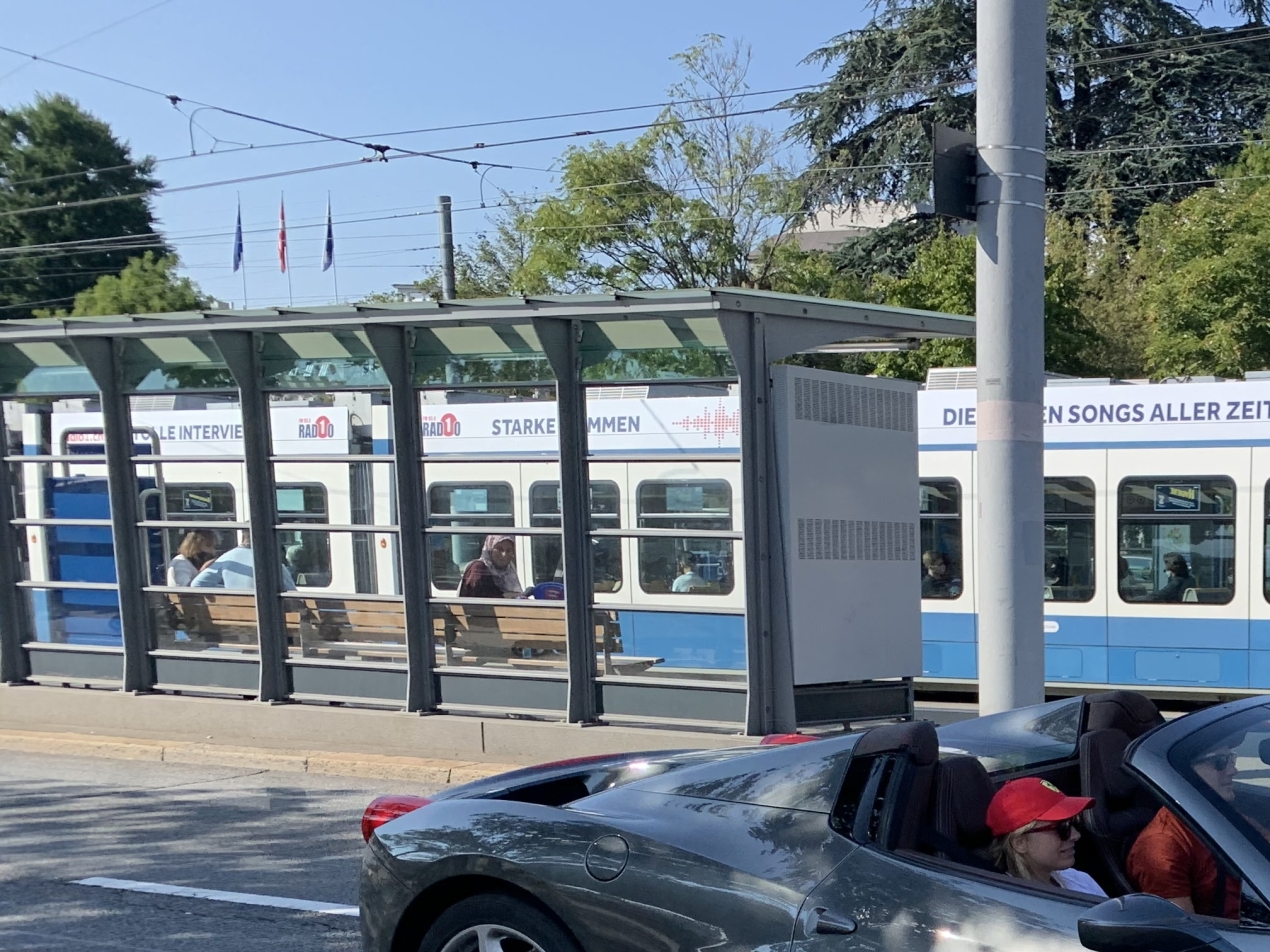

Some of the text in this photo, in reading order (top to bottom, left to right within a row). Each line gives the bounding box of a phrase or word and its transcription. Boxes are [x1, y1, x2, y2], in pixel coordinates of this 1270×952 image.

[943, 407, 977, 426] DIE
[1067, 403, 1145, 424] SONGS
[1149, 402, 1221, 422] ALLER
[178, 424, 244, 440] INTERVIE
[491, 415, 641, 436] STARKE MMEN
